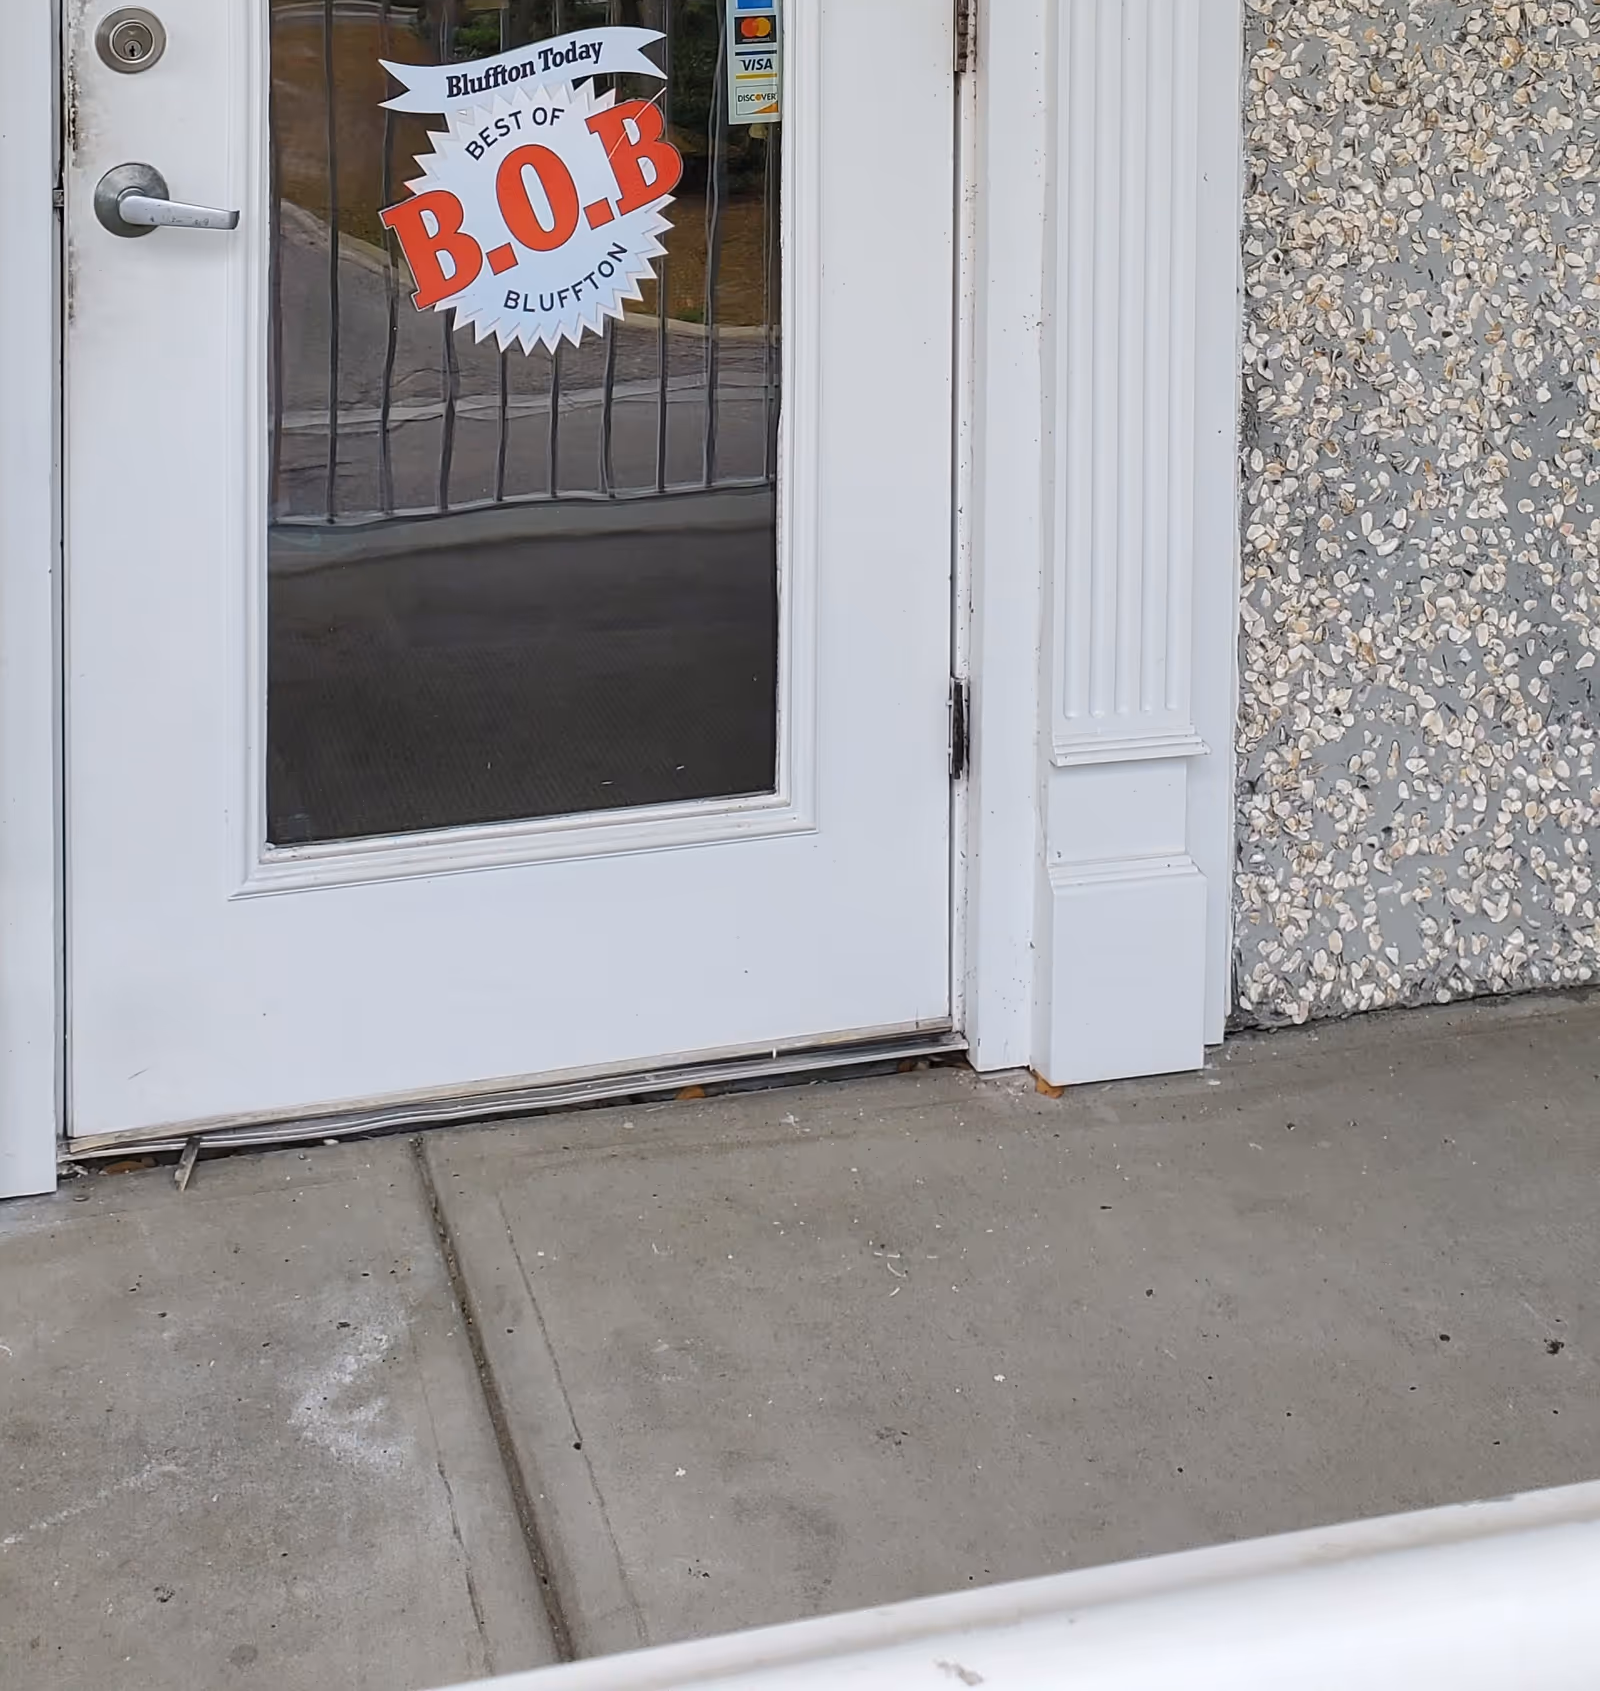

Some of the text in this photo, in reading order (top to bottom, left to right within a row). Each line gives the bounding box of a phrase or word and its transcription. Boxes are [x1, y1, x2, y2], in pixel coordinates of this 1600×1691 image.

[445, 41, 603, 98] Bluffton Today
[741, 58, 773, 71] VISA
[737, 92, 777, 103] DISCOVER
[464, 106, 565, 161] BEST OF
[380, 99, 683, 311] B.O.B
[503, 241, 628, 313] BLUFFTON
